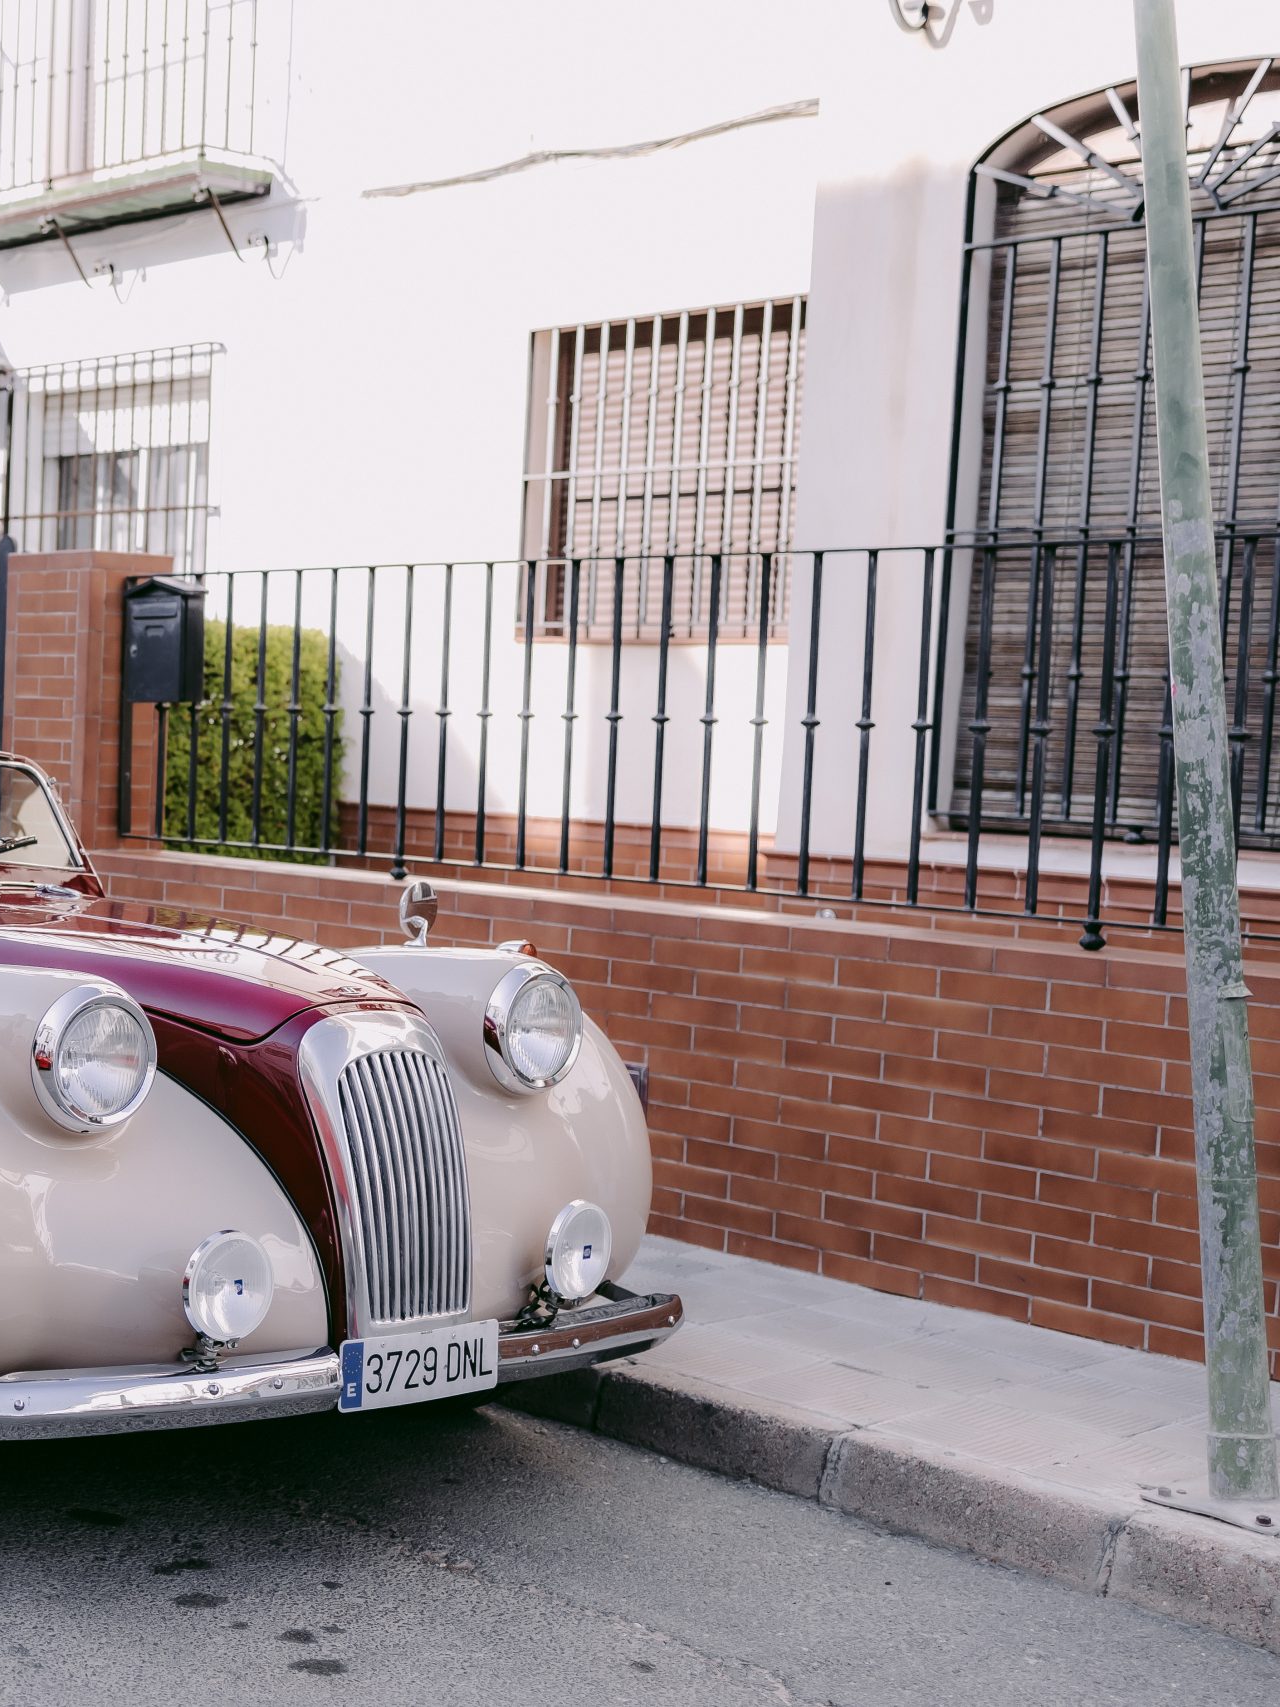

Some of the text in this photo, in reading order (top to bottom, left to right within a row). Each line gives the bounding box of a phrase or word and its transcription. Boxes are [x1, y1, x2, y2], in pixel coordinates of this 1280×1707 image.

[366, 1337, 493, 1394] 3729 DNL
[346, 1382, 357, 1398] E
